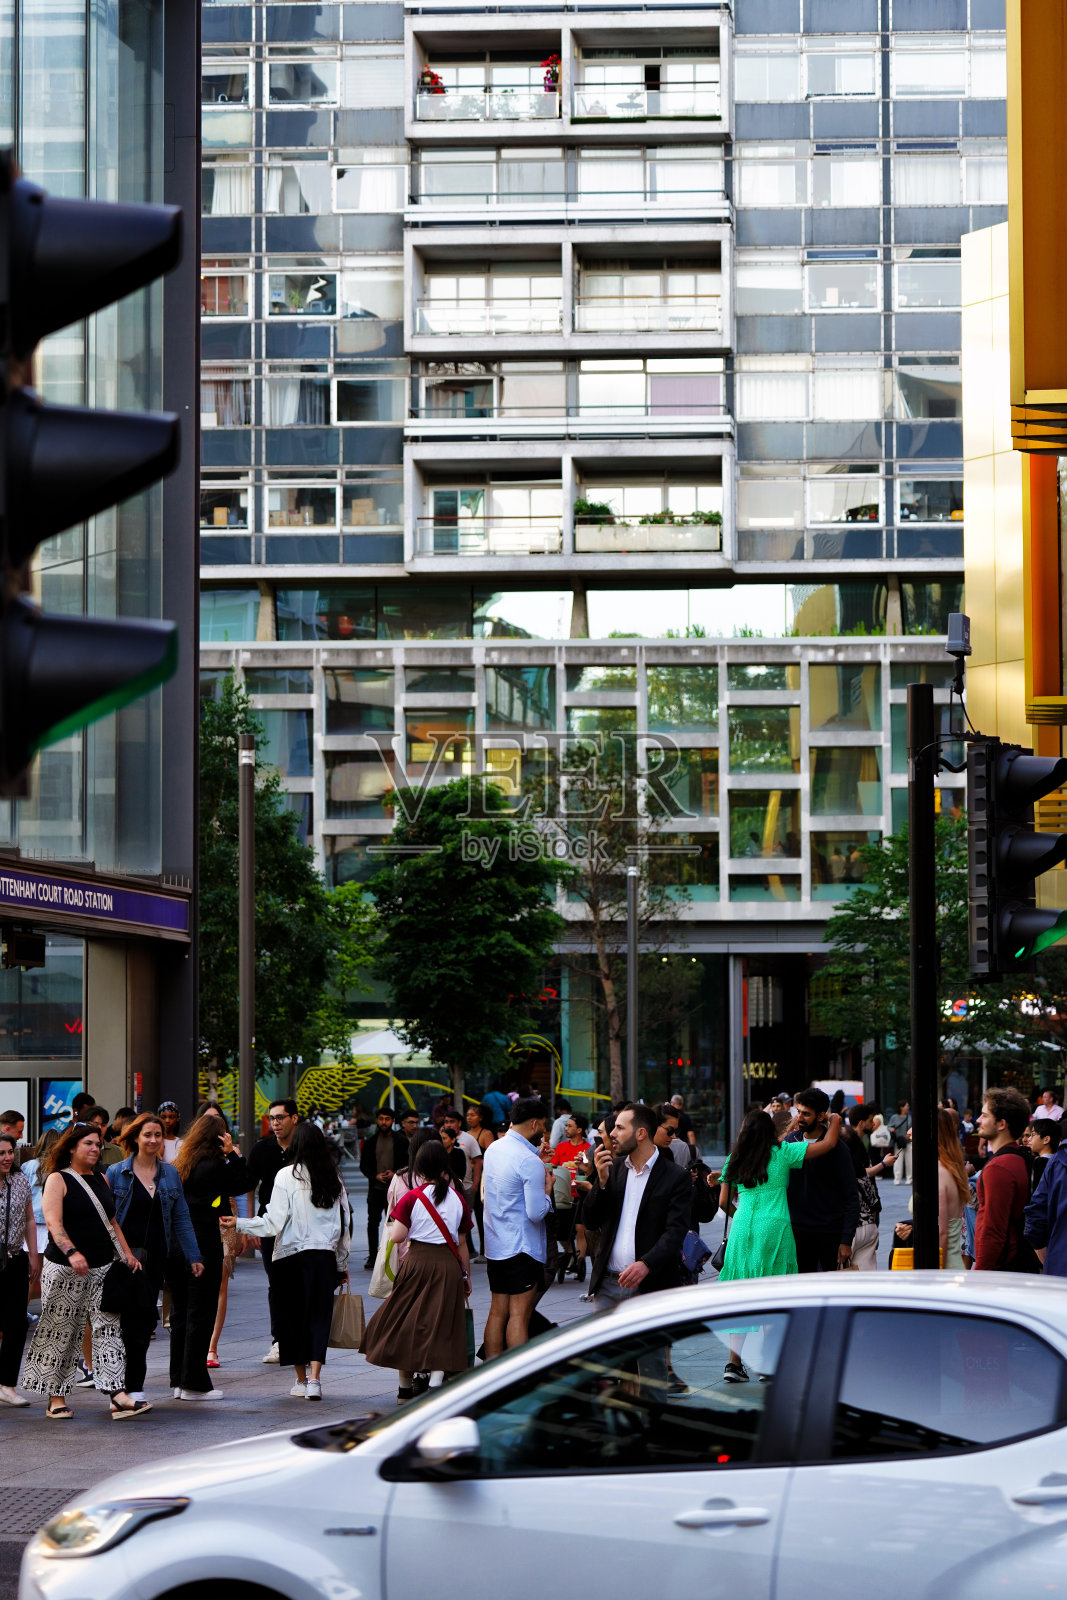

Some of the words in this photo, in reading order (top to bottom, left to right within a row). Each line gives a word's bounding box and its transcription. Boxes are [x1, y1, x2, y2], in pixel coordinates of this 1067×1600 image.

[0, 877, 36, 899] TTENHAM
[38, 883, 62, 903] COURT
[64, 887, 84, 907] ROAD
[85, 890, 113, 912] STATION
